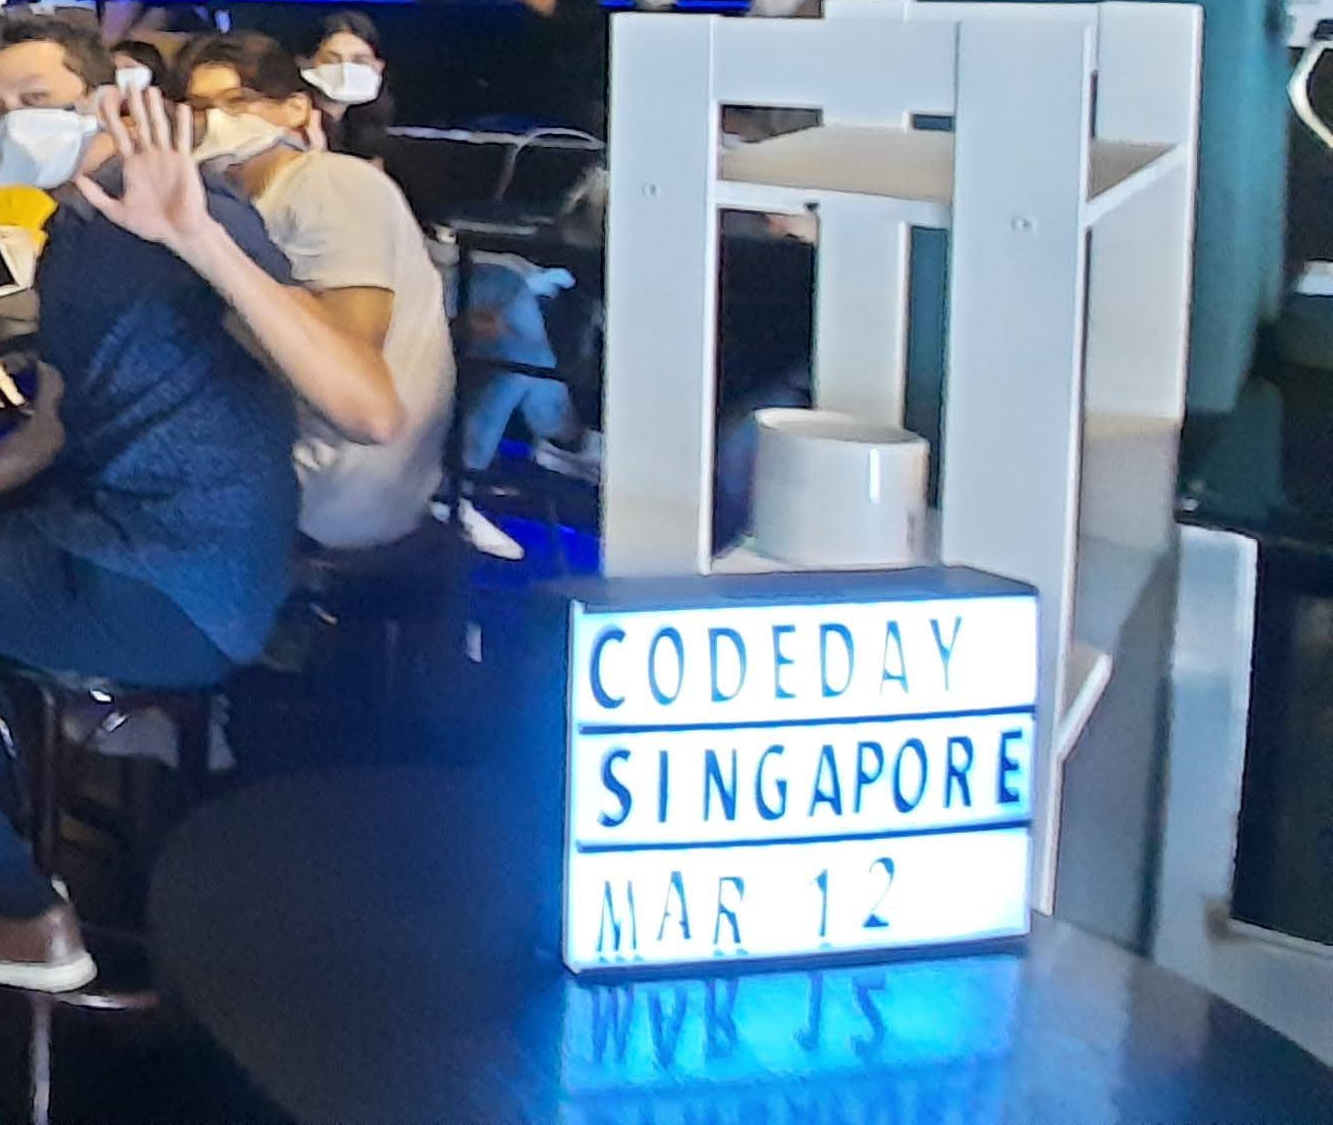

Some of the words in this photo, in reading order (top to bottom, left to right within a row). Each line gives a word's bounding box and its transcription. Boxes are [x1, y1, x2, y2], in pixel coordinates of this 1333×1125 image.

[588, 615, 964, 709] CODEDAY
[597, 728, 1024, 828] SINGAPORE
[595, 870, 746, 953] MAR
